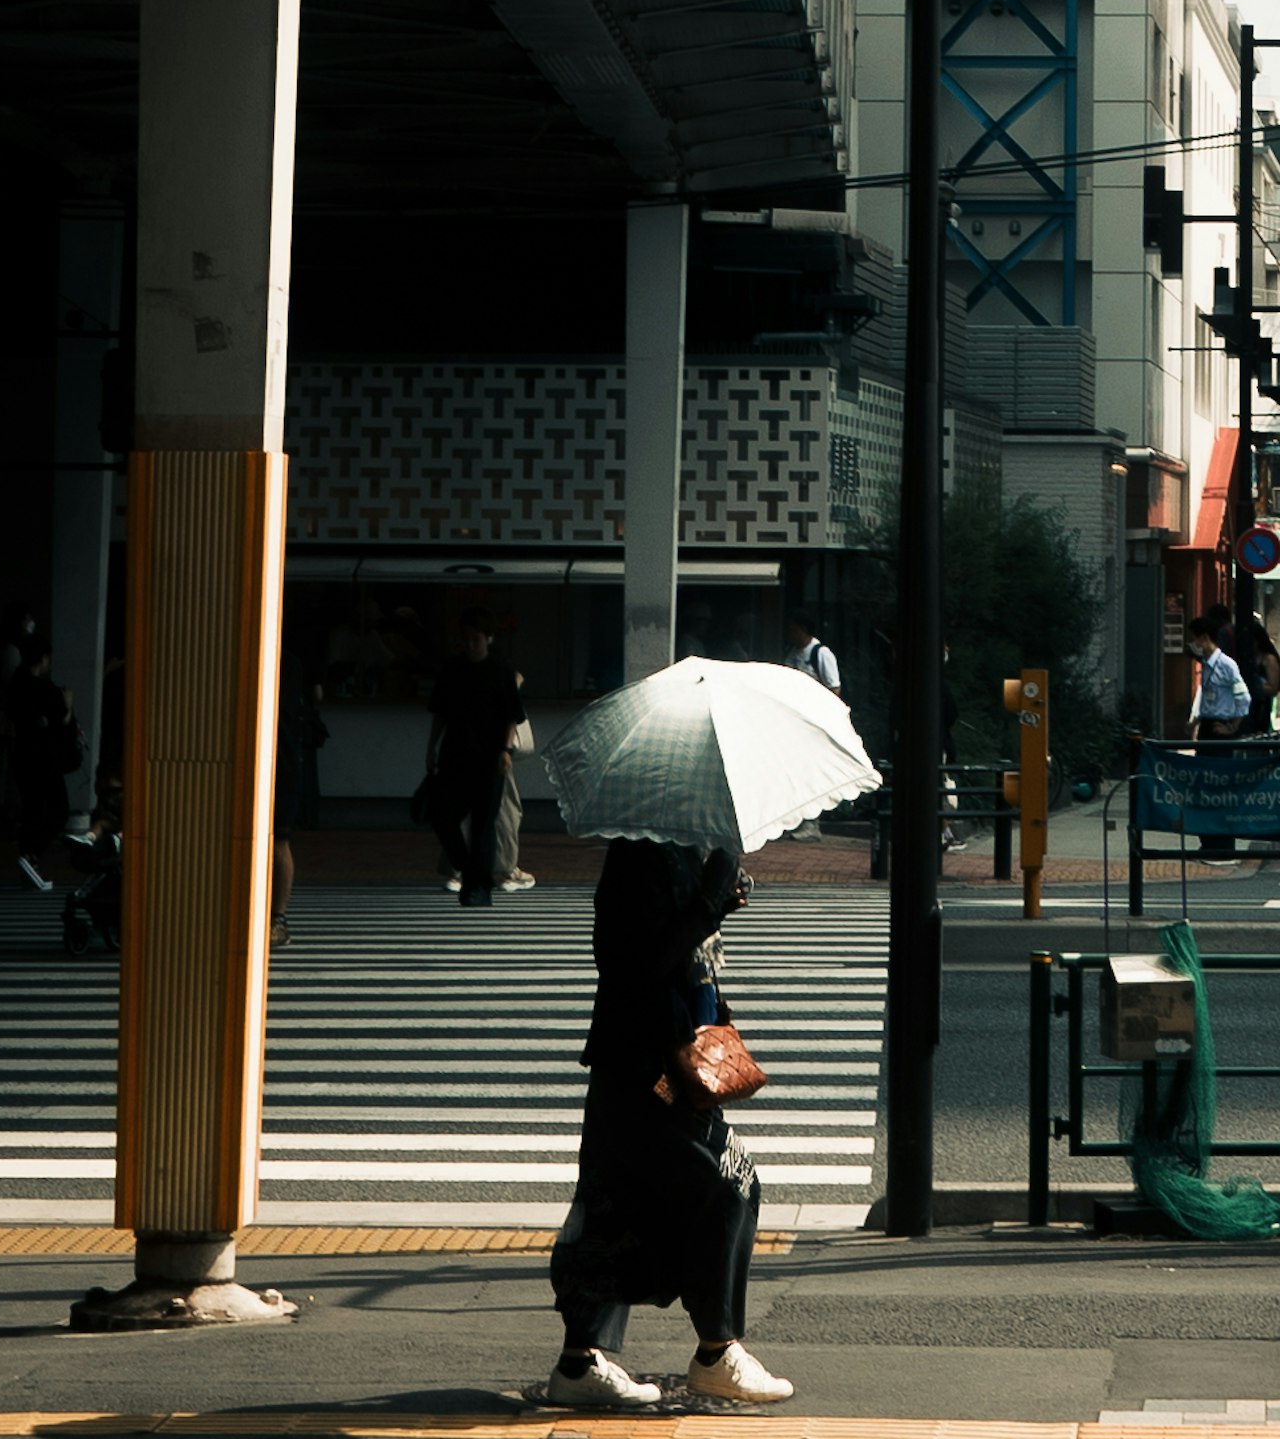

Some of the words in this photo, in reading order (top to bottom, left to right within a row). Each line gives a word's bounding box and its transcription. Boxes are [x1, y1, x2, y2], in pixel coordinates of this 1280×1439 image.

[1154, 760, 1198, 787] Obey
[1203, 770, 1230, 786] the
[1152, 785, 1194, 805] Look
[1200, 789, 1239, 807] both
